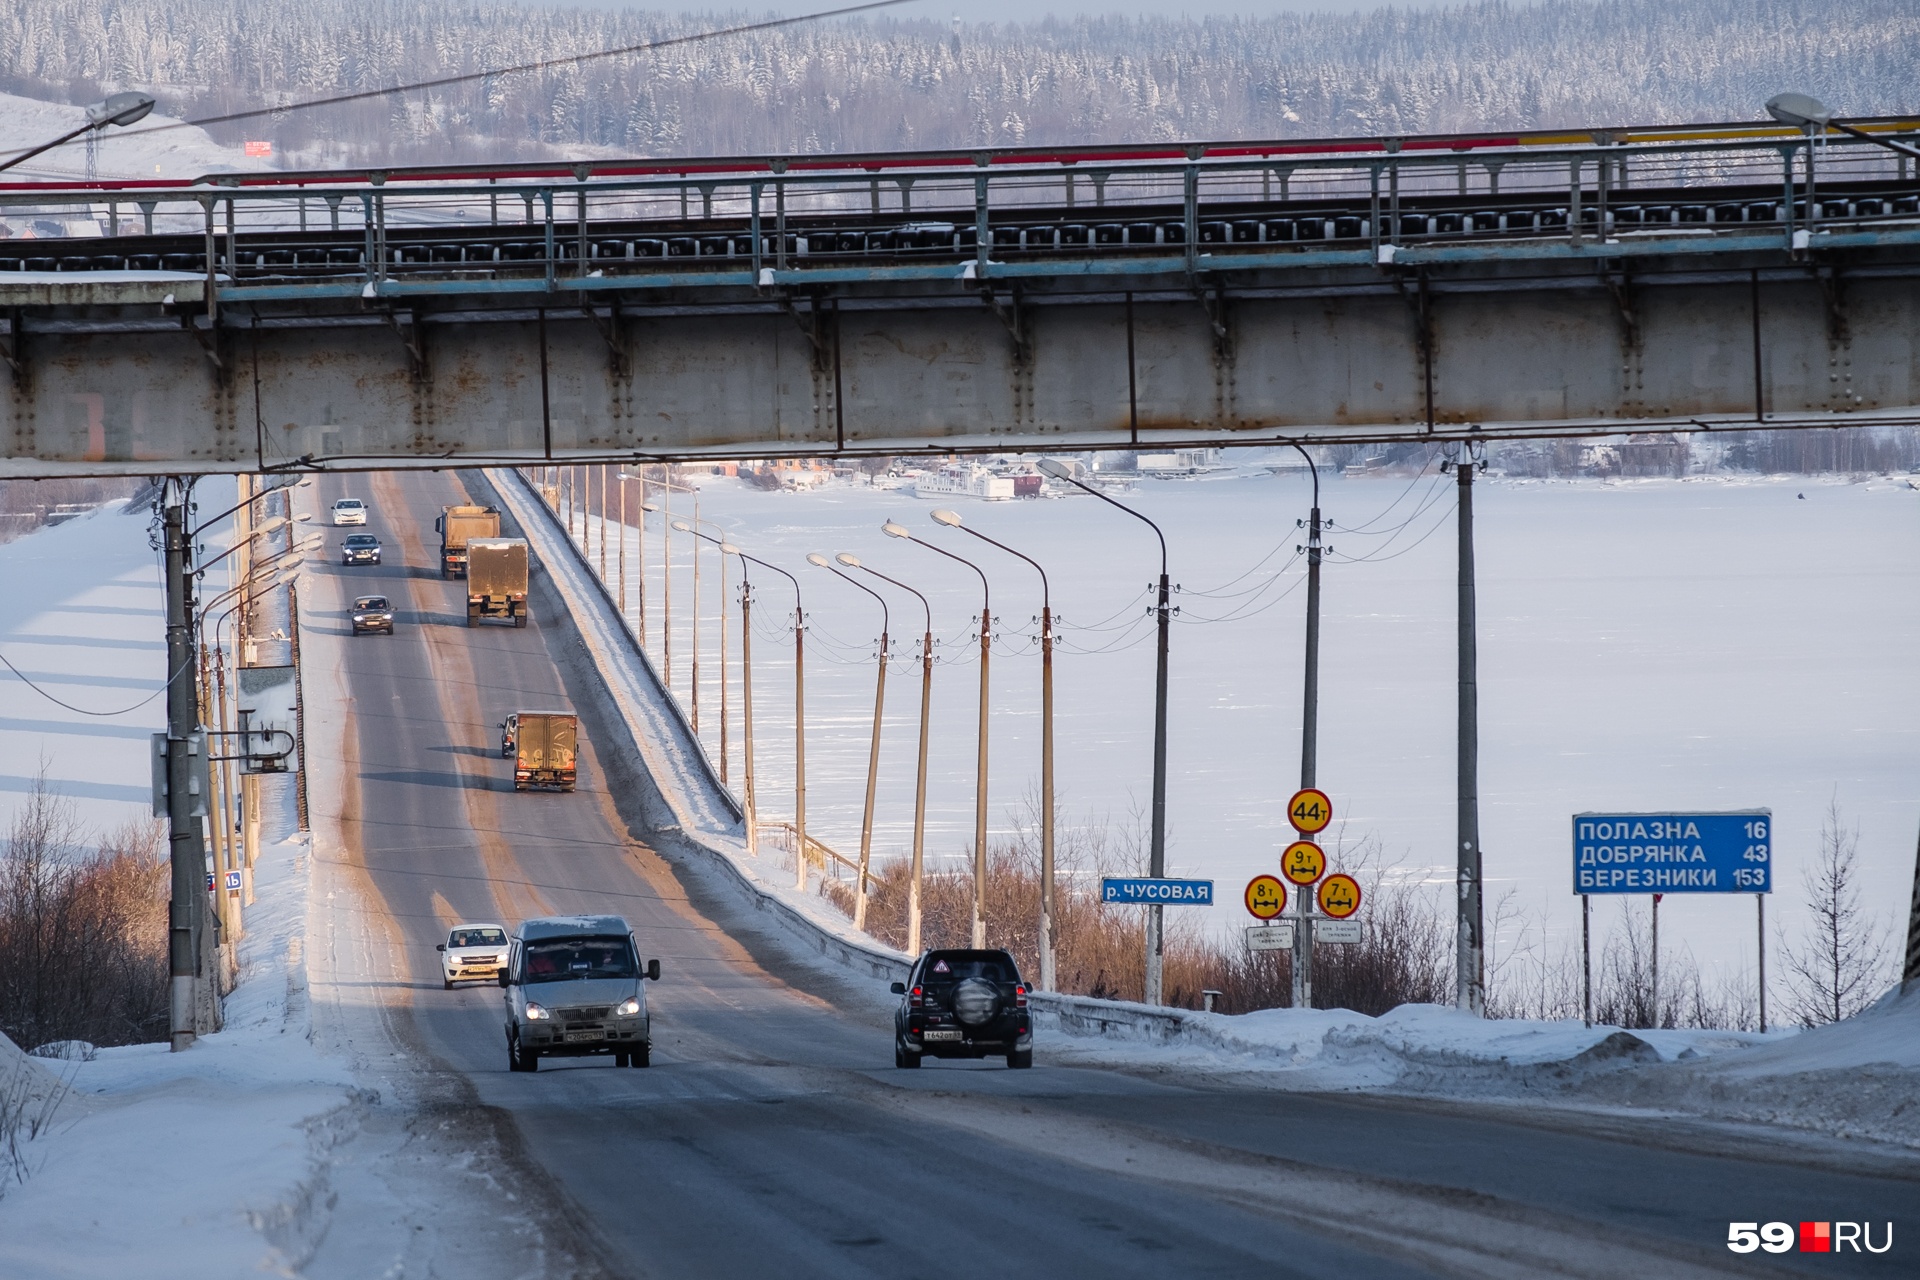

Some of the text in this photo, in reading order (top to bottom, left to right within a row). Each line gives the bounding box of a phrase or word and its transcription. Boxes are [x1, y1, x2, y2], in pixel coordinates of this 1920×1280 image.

[1579, 821, 1767, 840] ПОЛАЗНА 16
[1579, 844, 1768, 867] ДОБРЯНКА 43
[1579, 868, 1766, 887] БЕРЕЗНИКИ 153
[1106, 884, 1209, 900] р. ЧУСОВАЯ
